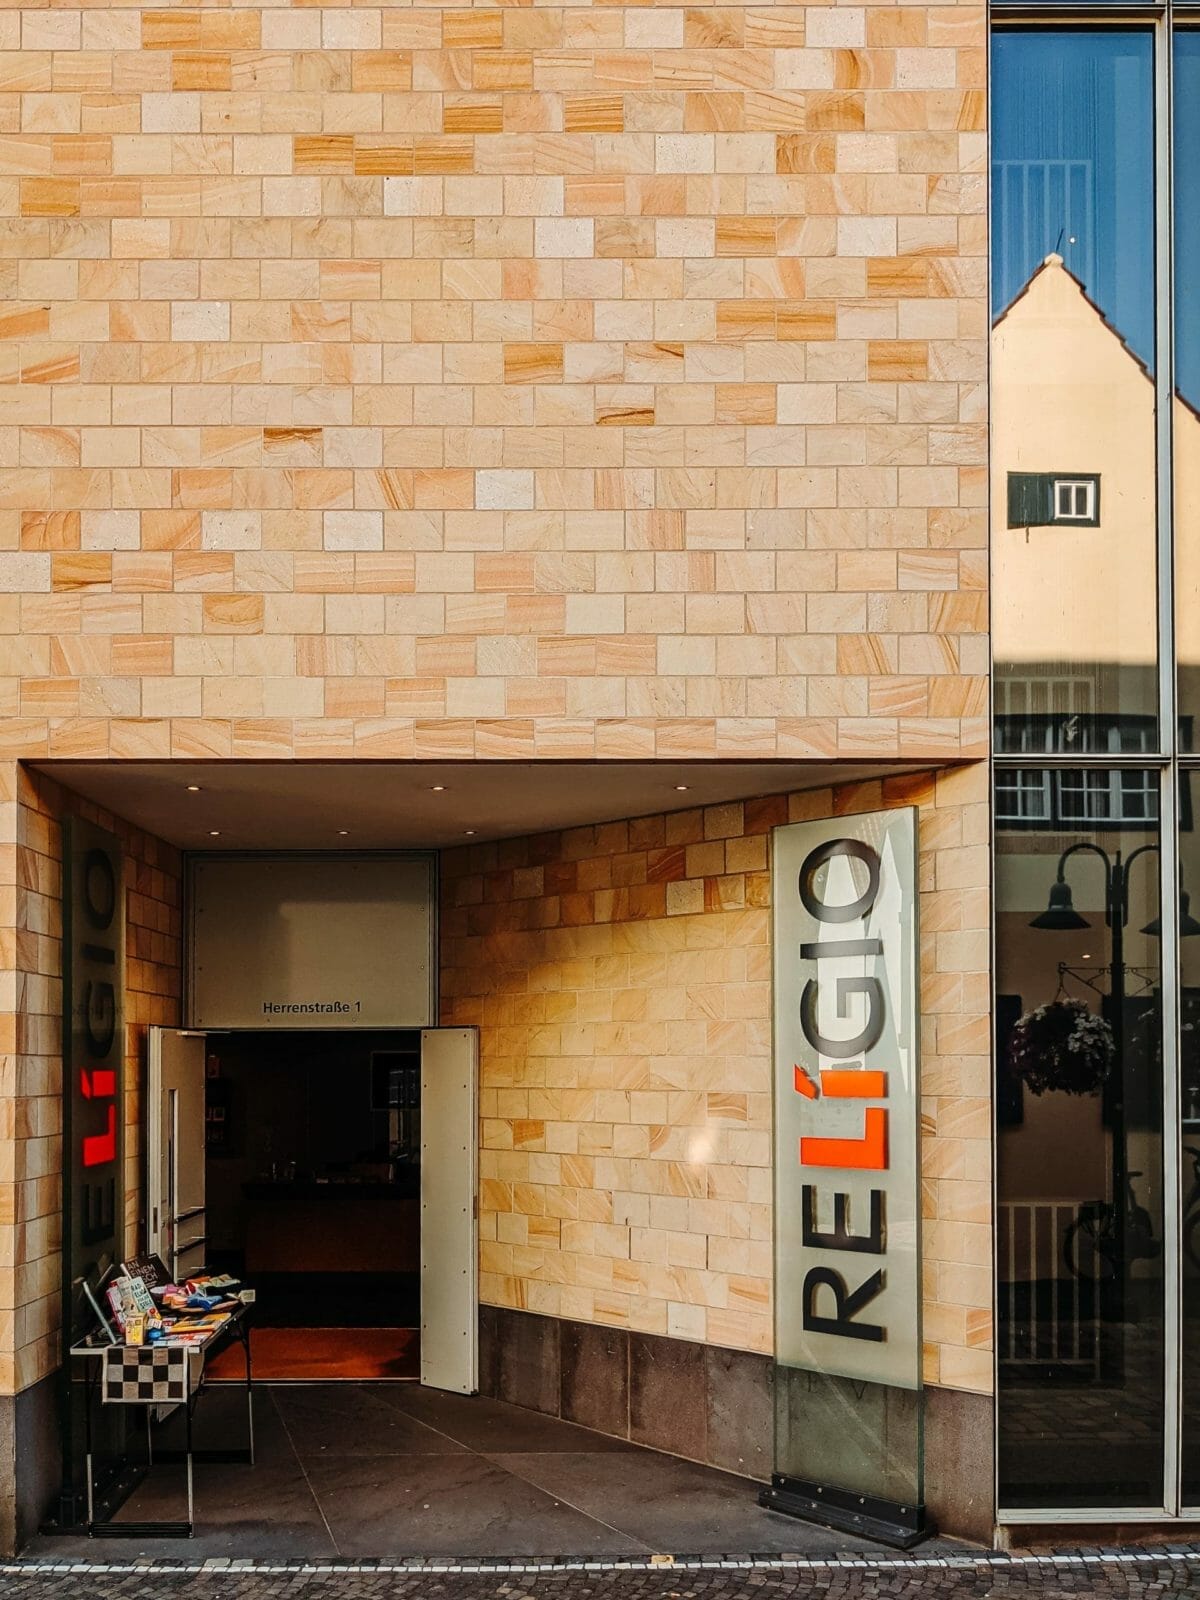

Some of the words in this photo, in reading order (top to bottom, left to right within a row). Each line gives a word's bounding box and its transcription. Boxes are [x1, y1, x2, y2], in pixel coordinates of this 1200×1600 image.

[80, 847, 116, 1272] ELÍGIO
[263, 1002, 350, 1013] Herrenstraße
[354, 1001, 361, 1012] 1
[794, 838, 888, 1341] RELÍGIO
